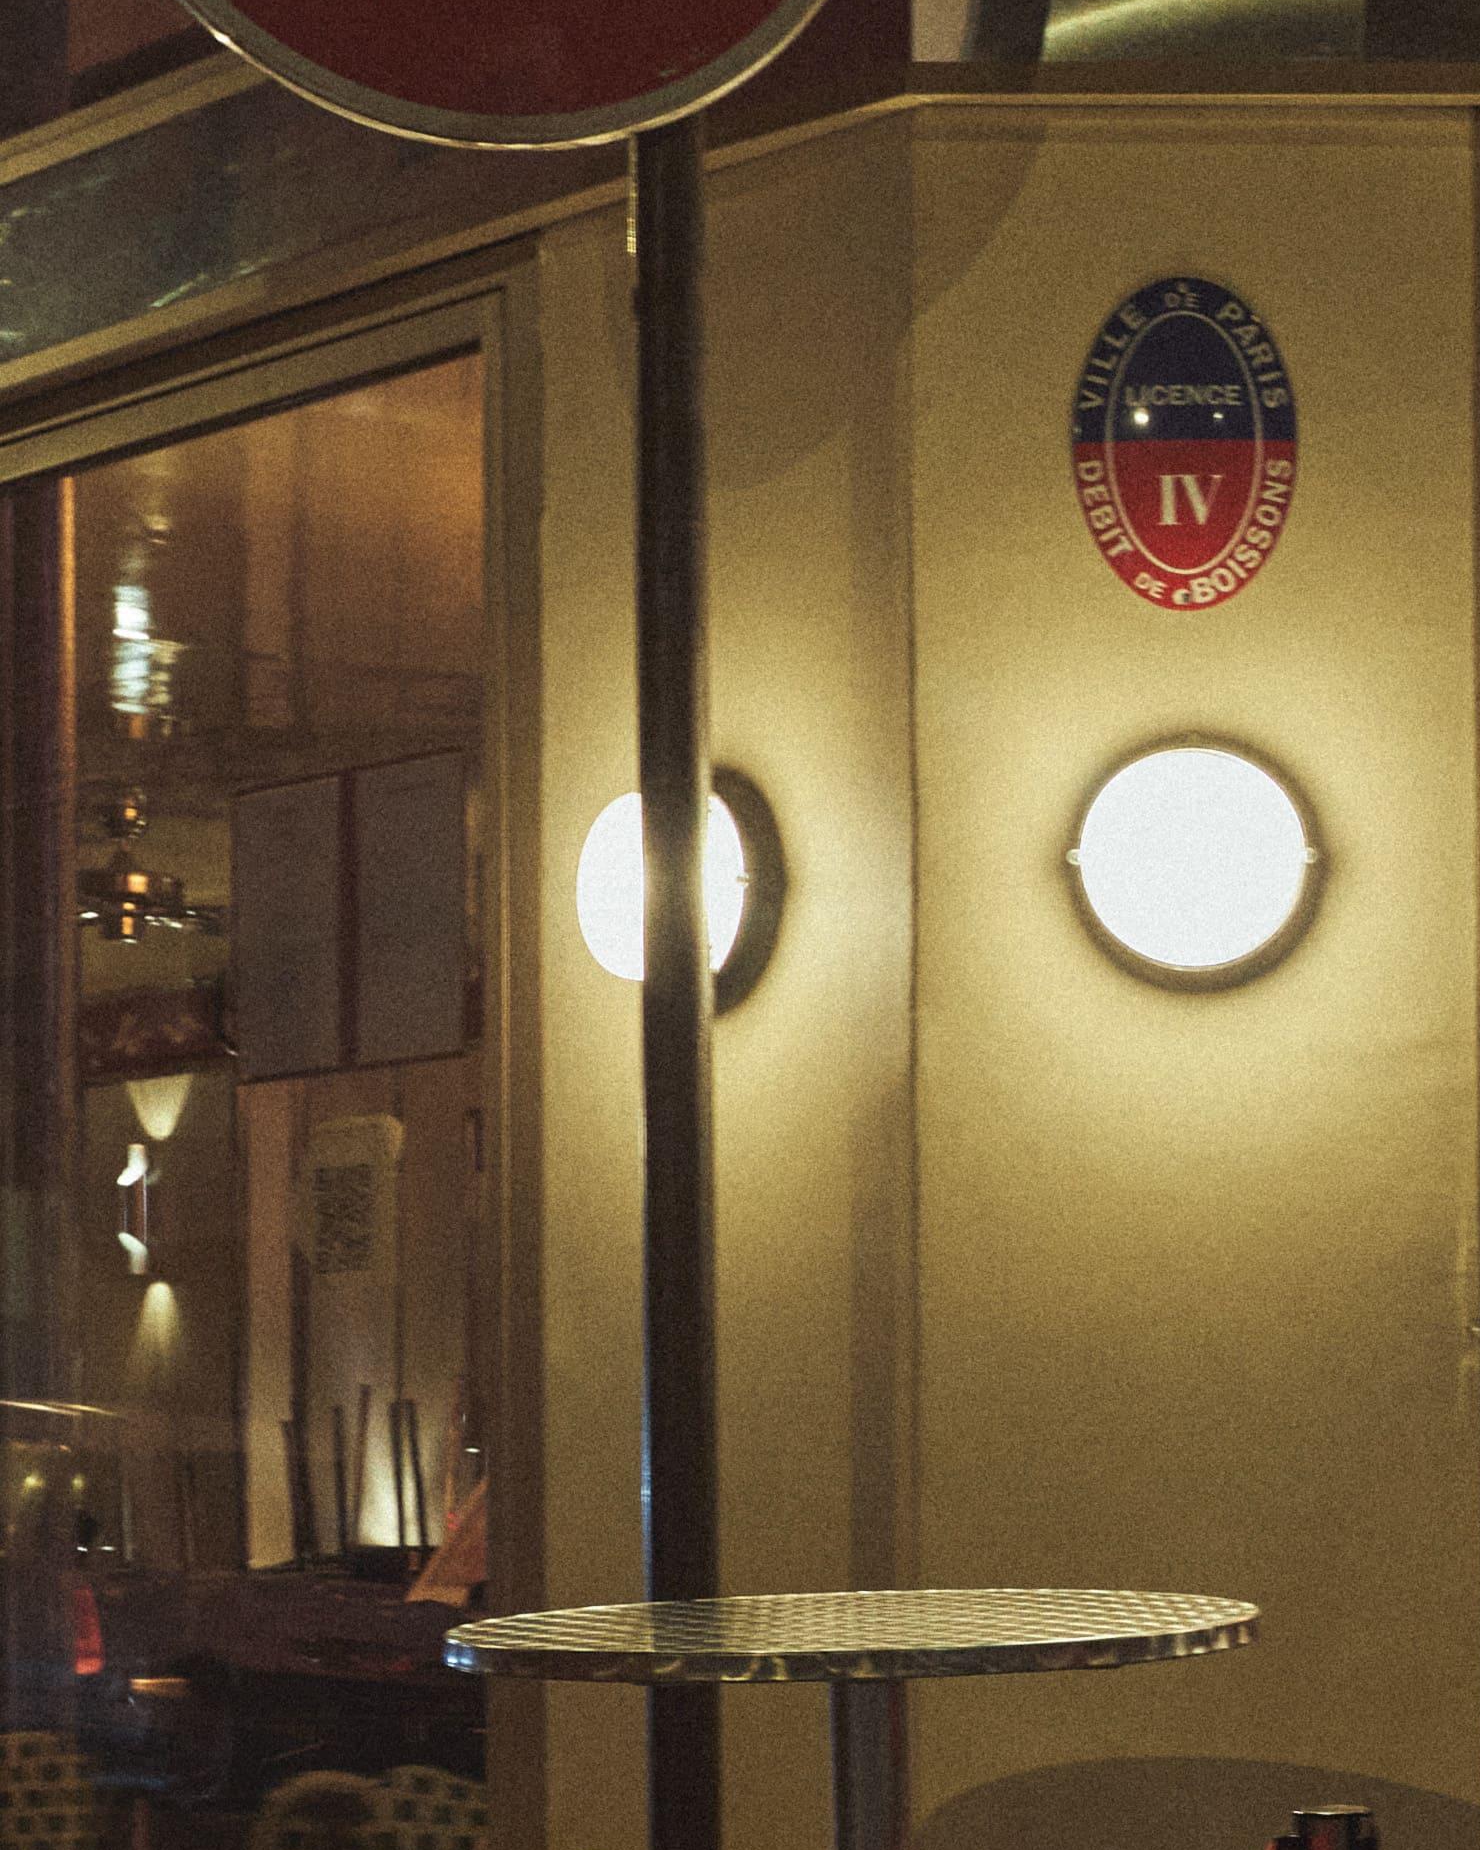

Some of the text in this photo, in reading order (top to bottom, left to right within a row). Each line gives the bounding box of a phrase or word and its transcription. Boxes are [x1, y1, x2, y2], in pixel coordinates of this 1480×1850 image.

[1078, 292, 1290, 408] VILLE DE PARIS
[1125, 385, 1242, 405] LICENCE
[1134, 571, 1168, 599] DE
[1189, 459, 1293, 603] BOISSONS
[1158, 474, 1223, 526] IV
